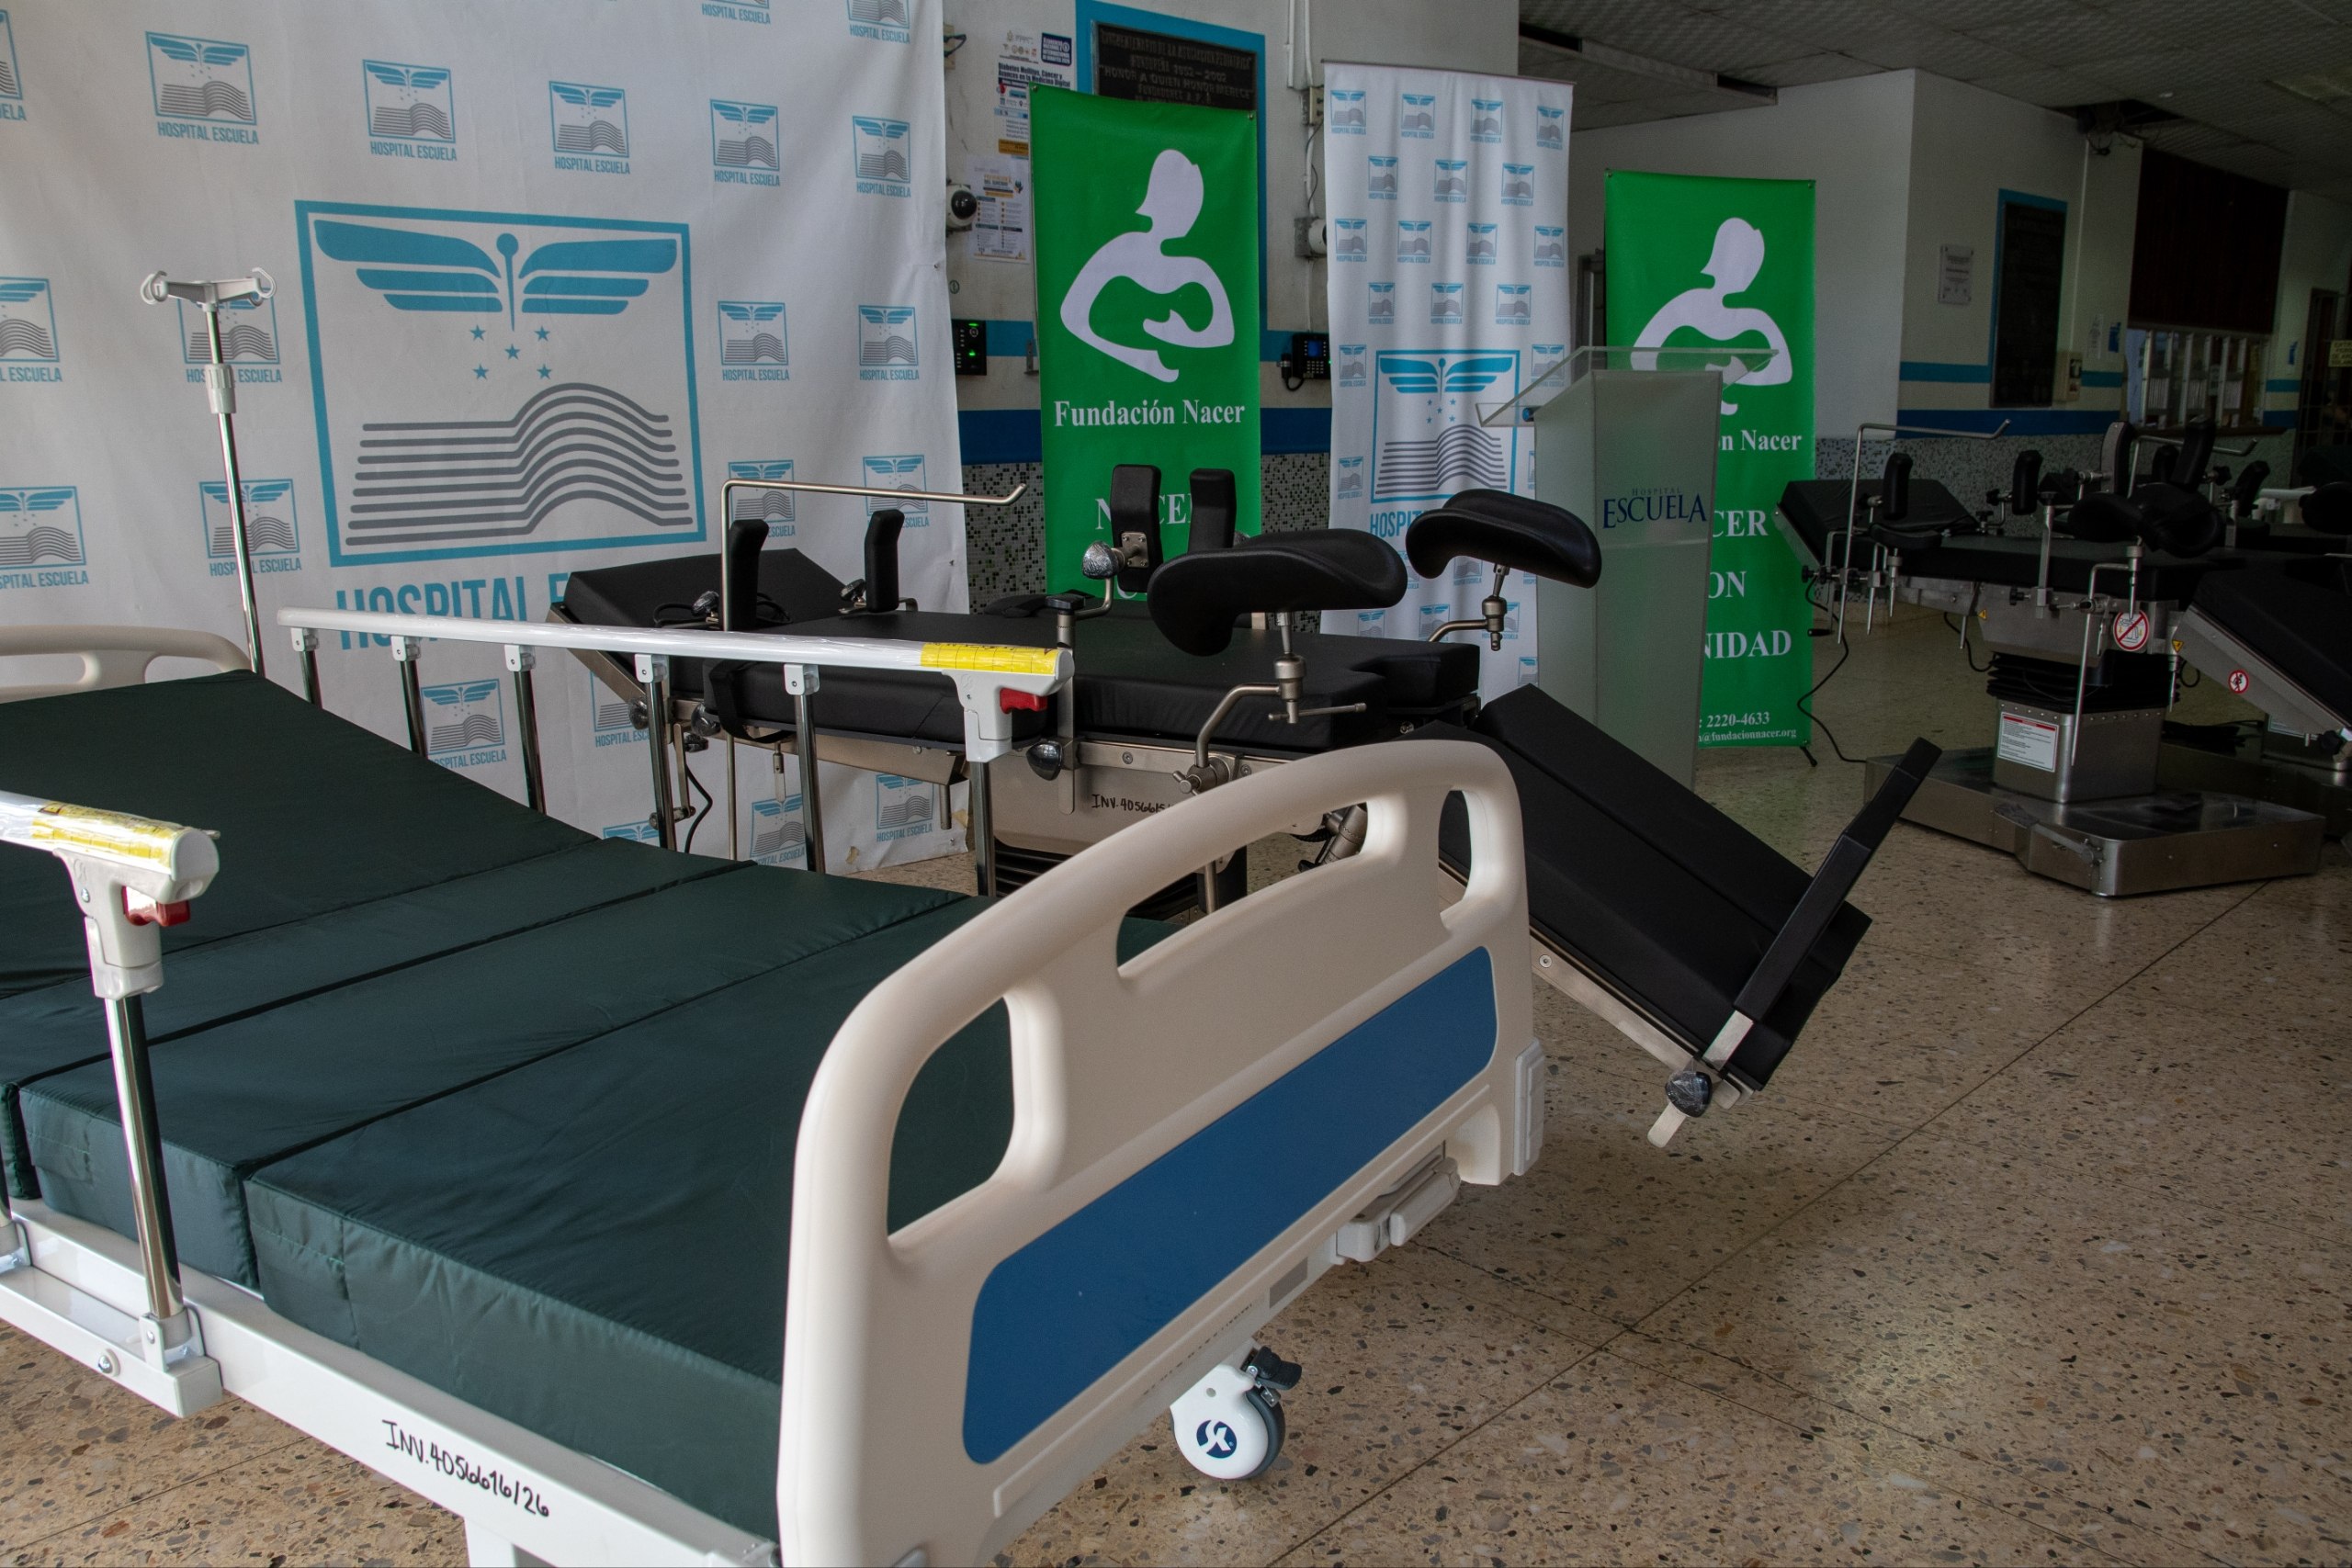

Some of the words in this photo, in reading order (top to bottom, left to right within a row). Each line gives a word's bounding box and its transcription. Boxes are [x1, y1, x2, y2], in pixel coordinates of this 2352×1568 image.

[701, 4, 738, 20] HOSPITAL
[739, 8, 771, 24] ESCUELA
[850, 25, 880, 39] HOSPITAL
[881, 28, 910, 44] ESCUELA
[157, 121, 210, 141] HOSPITAL
[212, 127, 259, 144] ESCUELA
[370, 141, 415, 158] HOSPITAL
[417, 144, 458, 161] ESCUELA
[554, 156, 594, 172] HOSPITAL
[595, 160, 631, 175] ESCUELA
[713, 169, 749, 184] HOSPITAL
[750, 173, 781, 186] ESCUELA
[856, 182, 886, 196] HOSPITAL
[887, 185, 911, 197] ESCUELA
[9, 367, 62, 382] ESCUELA
[238, 369, 283, 383] ESCUELA
[722, 370, 758, 381] HOSPITAL
[759, 370, 789, 381] ESCUELA
[859, 369, 888, 380] HOSPITAL
[888, 369, 919, 380] ESCUELA
[1055, 399, 1175, 426] Fundación
[1182, 399, 1246, 424] Nacer
[1740, 429, 1803, 451] Nacer
[1632, 487, 1682, 496] HOSPITAL
[1602, 493, 1707, 529] ESCUELA
[209, 560, 258, 576] HOSPL
[260, 558, 302, 573] ESCUELA
[0, 573, 37, 589] PITAL
[38, 570, 89, 587] ESCUELA
[1708, 571, 1747, 599] ON
[1706, 711, 1770, 728] 2220-4633
[595, 733, 632, 748] HOSPITAL
[469, 749, 507, 765] ESCUELA
[876, 829, 905, 842] HOSPITAL
[906, 823, 933, 837] ESCUELA
